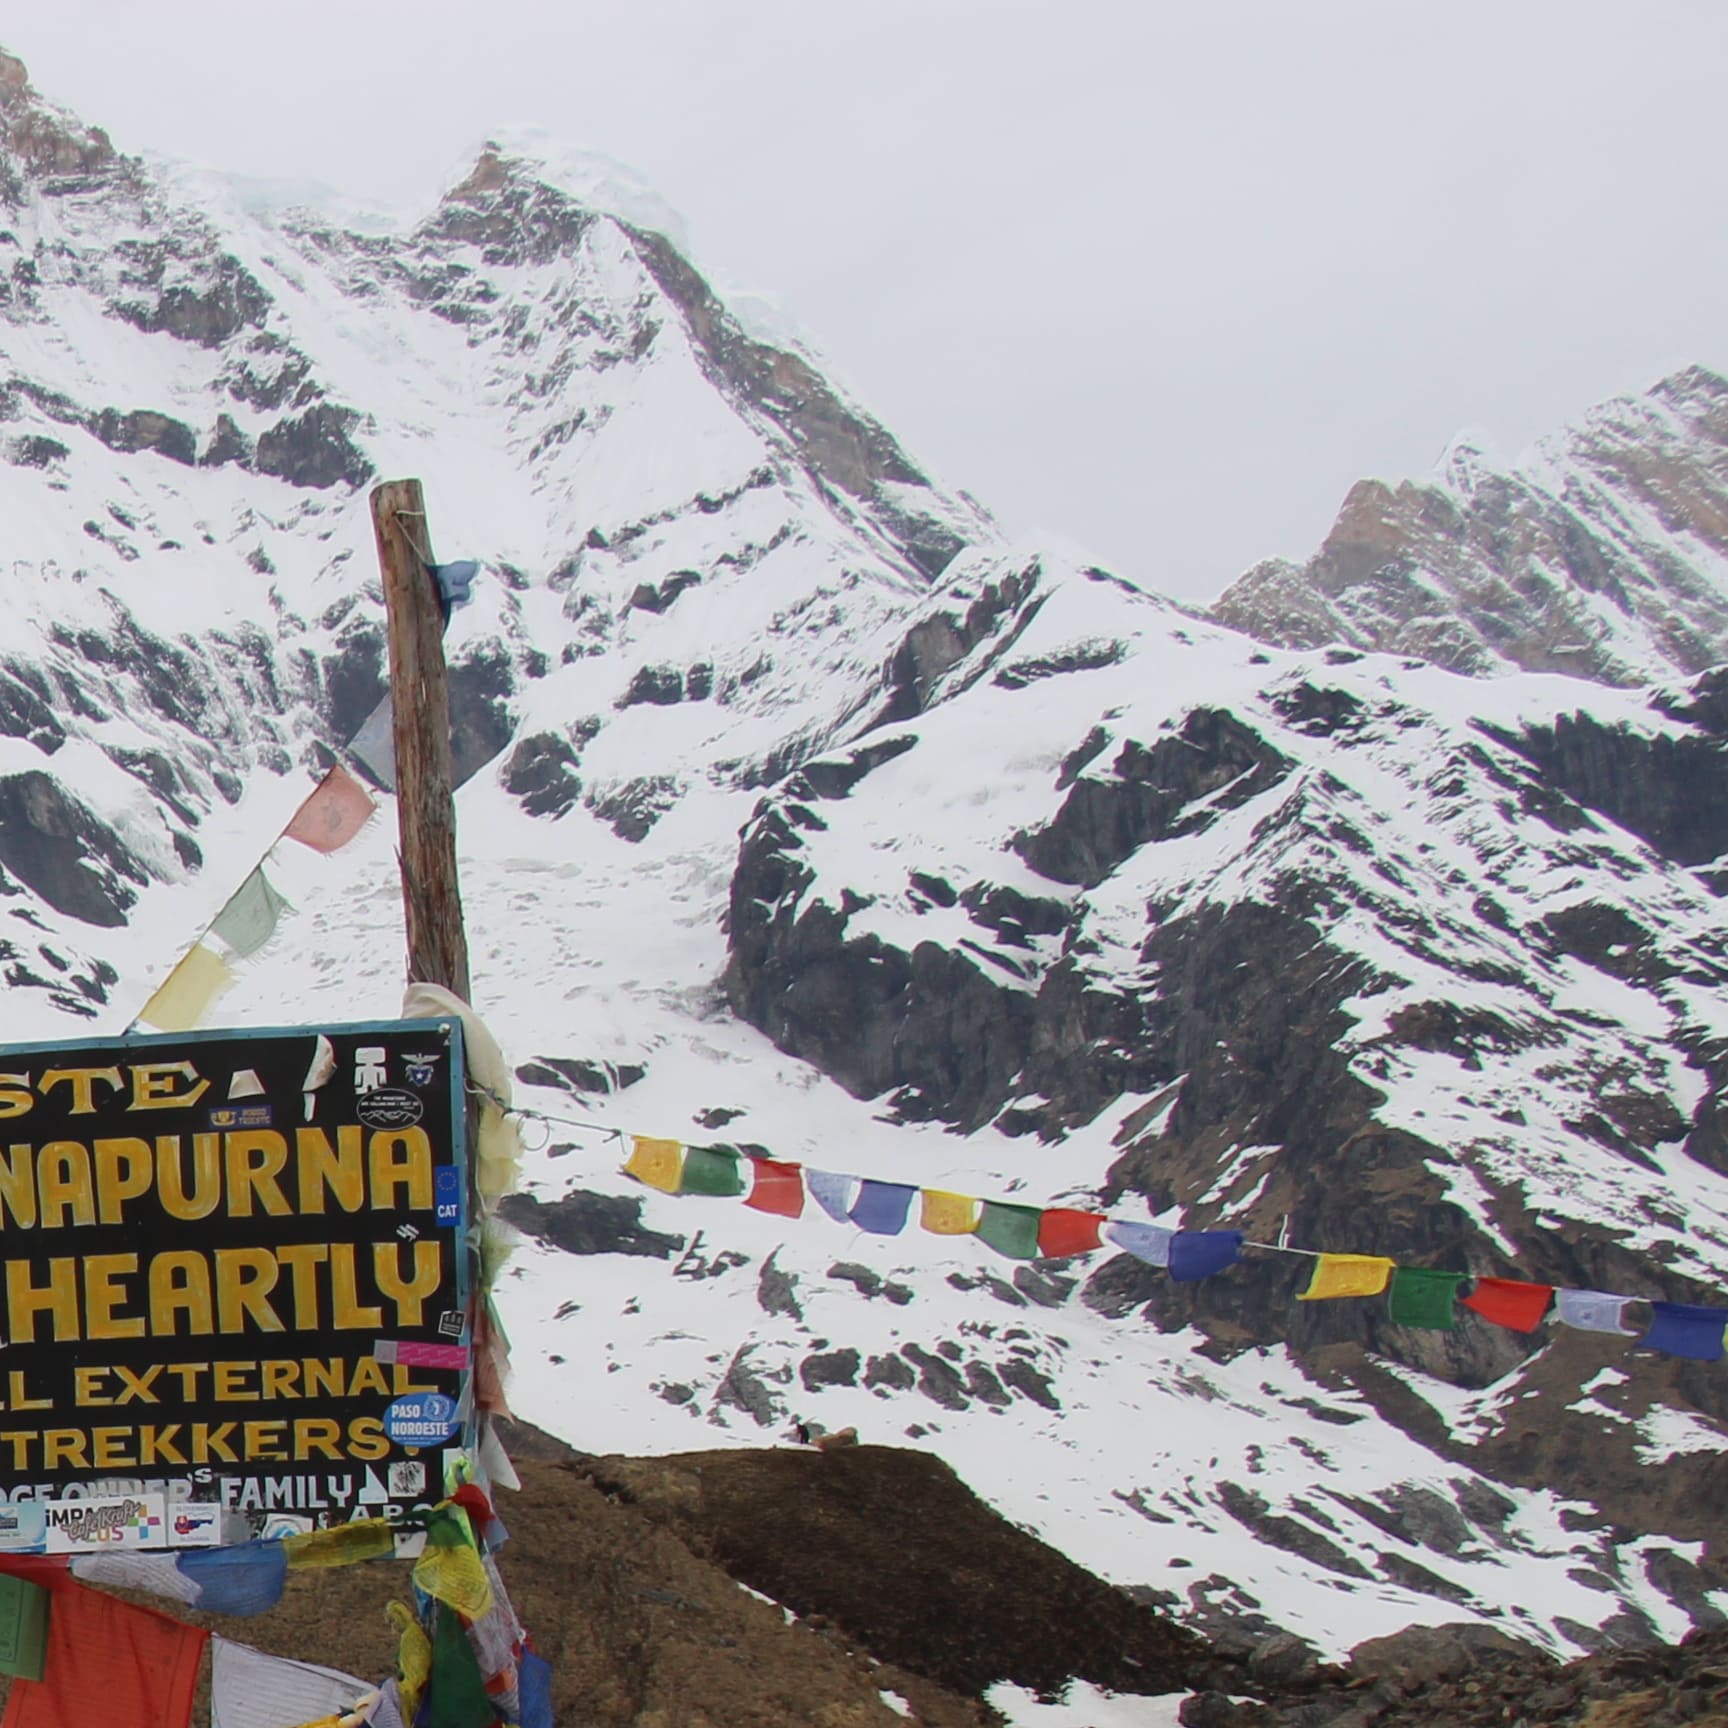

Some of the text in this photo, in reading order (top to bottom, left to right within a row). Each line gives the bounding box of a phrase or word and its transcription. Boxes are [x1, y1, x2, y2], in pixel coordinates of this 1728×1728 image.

[437, 1204, 458, 1219] CAT
[5, 1241, 442, 1344] HEARTLY
[74, 1356, 439, 1407] EXTERNAL
[391, 1403, 421, 1419] PASO
[391, 1421, 449, 1437] NOROESTE
[220, 1474, 352, 1511] FAMILY
